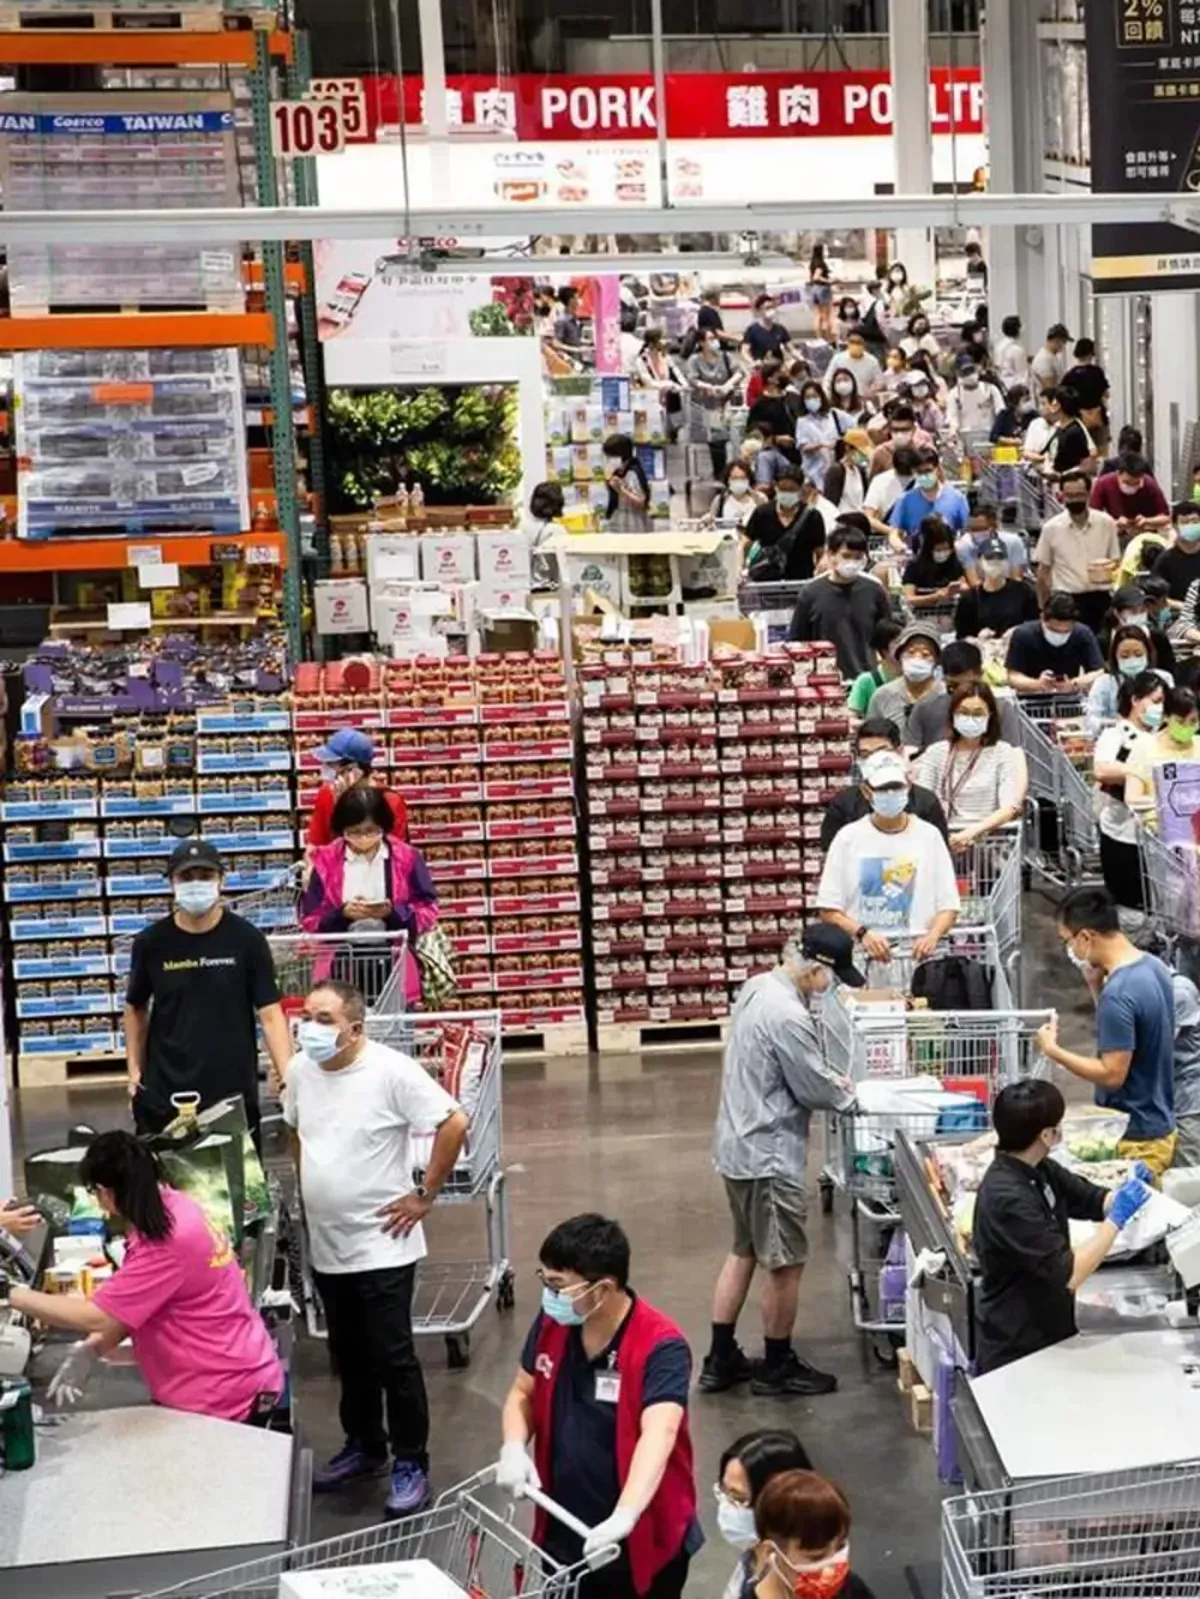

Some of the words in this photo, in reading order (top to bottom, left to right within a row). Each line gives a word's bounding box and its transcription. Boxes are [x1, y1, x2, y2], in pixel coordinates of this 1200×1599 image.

[1124, 21, 1163, 40] 回饋
[122, 115, 204, 130] TAIWAN
[541, 87, 657, 129] PORK
[726, 84, 819, 127] 雞肉
[845, 83, 984, 126] POLTR
[275, 106, 339, 152] 103
